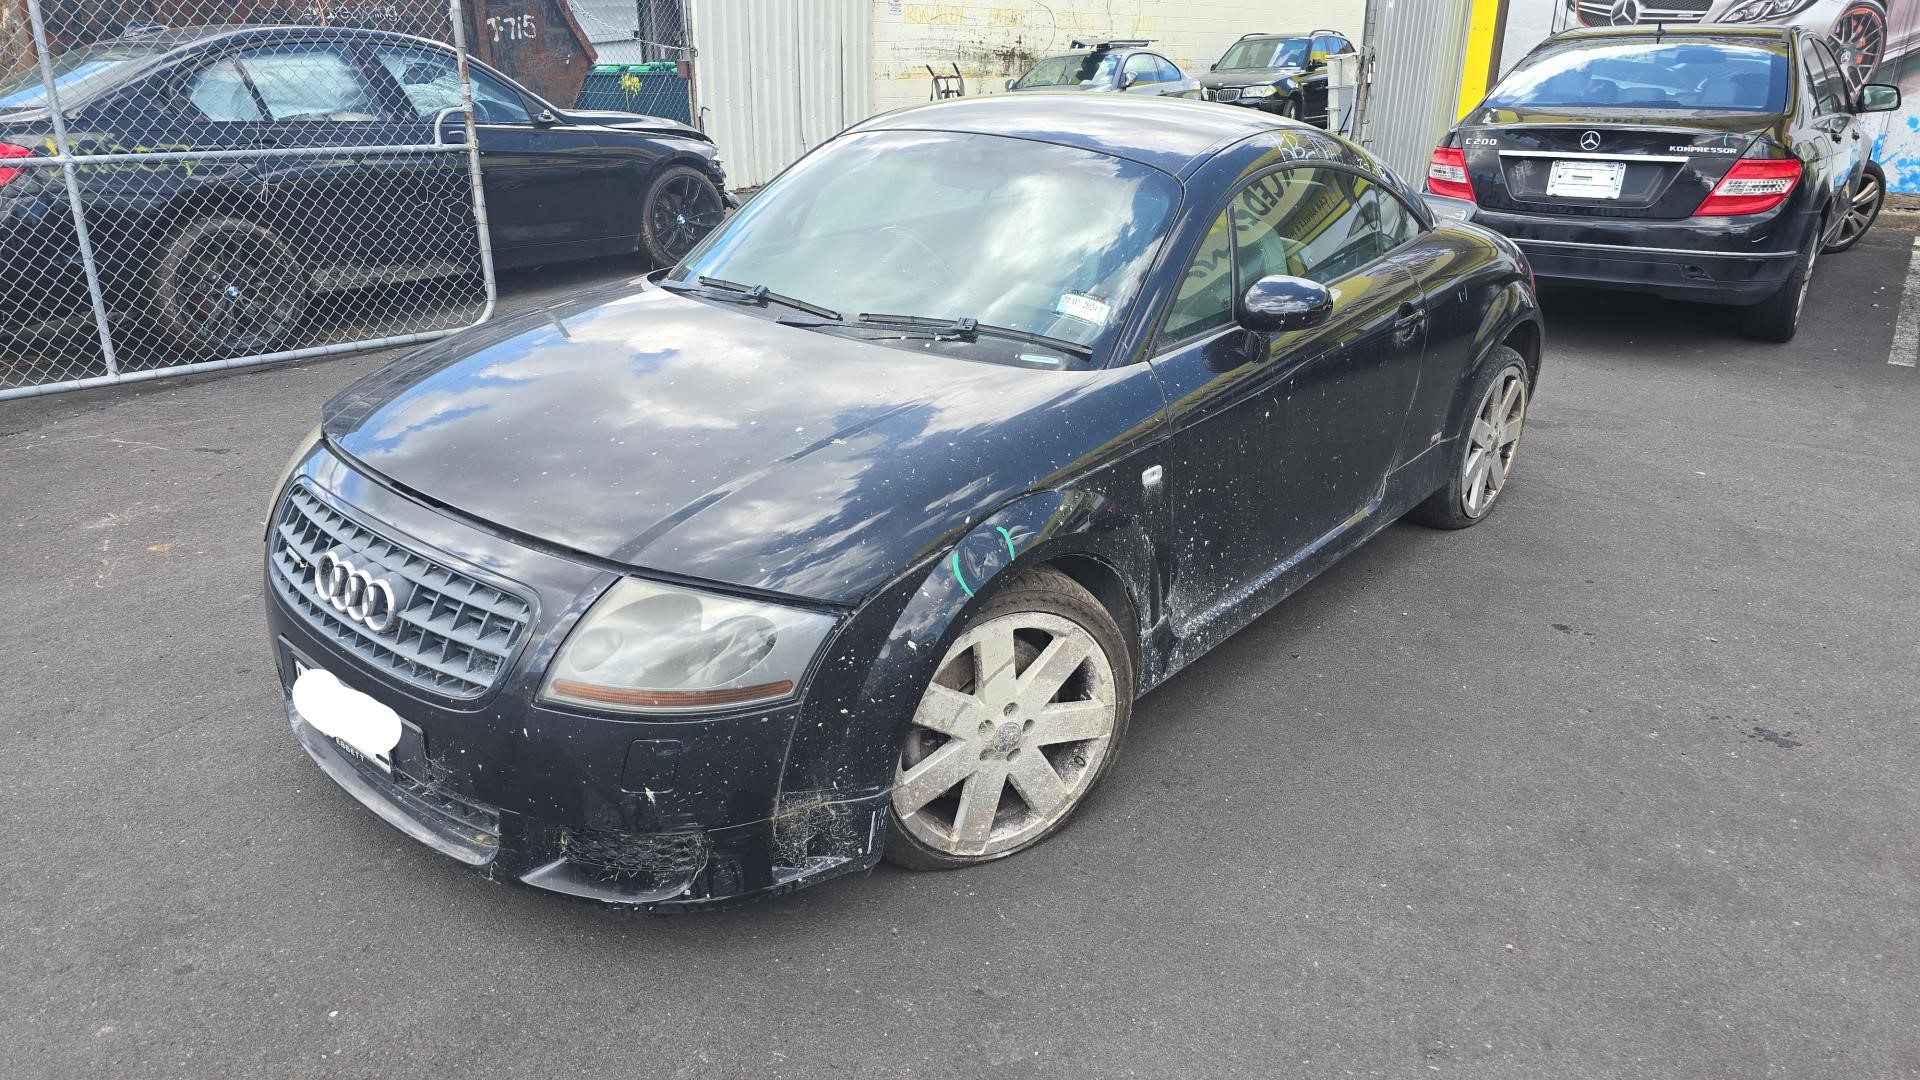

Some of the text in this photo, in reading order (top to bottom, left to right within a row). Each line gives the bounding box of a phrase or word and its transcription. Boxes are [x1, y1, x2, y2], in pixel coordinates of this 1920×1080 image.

[1465, 137, 1498, 146] C 200
[335, 737, 365, 762] EBBETT
